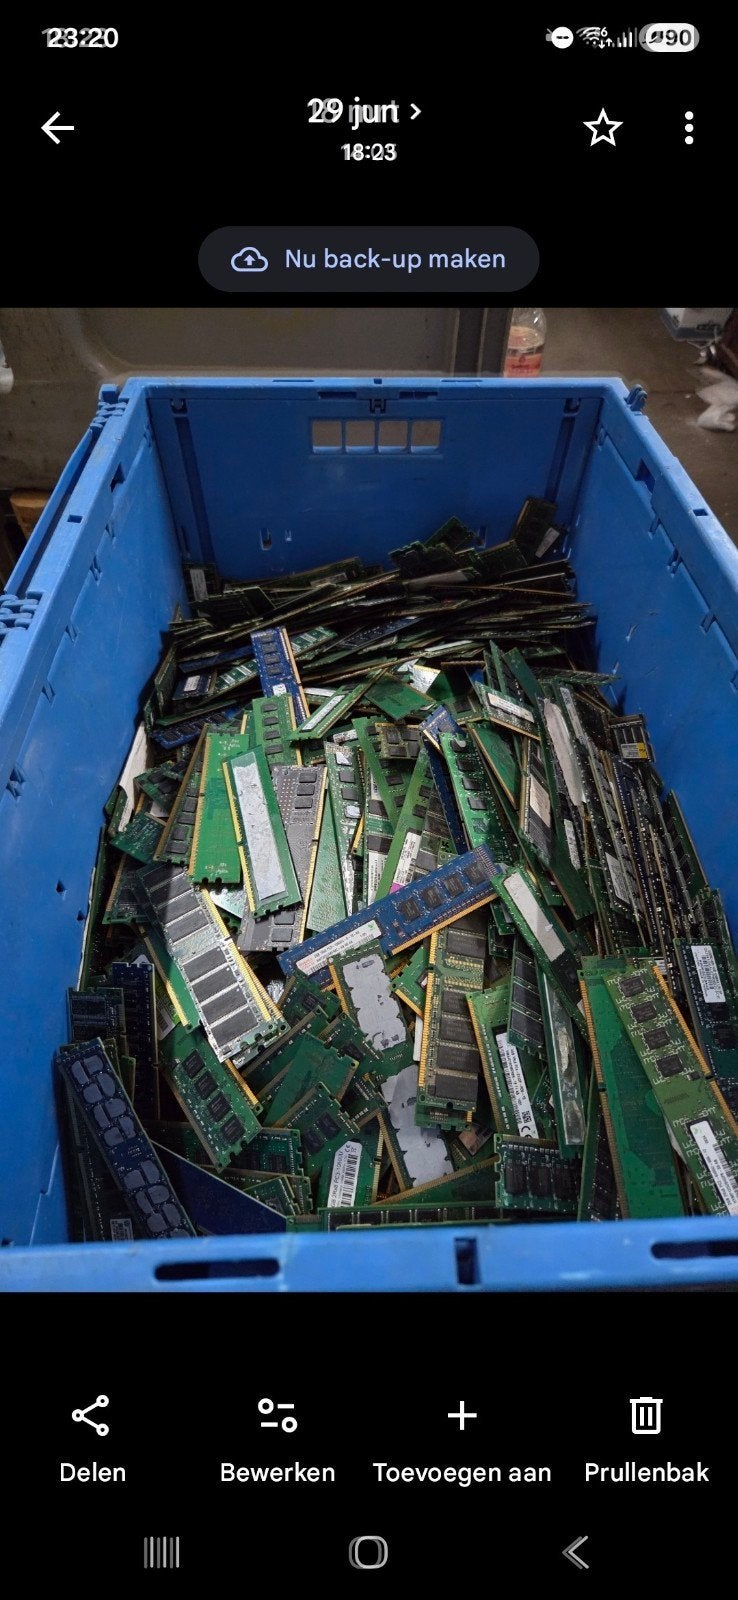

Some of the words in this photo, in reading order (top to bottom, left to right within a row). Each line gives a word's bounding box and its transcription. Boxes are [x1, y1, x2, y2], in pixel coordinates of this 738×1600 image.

[665, 29, 692, 46] 90
[307, 98, 344, 123] 29
[341, 143, 397, 161] 18:23
[286, 249, 315, 268] Nu
[325, 248, 421, 273] back-up
[429, 248, 505, 268] maken
[61, 1462, 125, 1482] Delen
[221, 1462, 335, 1482] Bewerken
[373, 1462, 501, 1487] Toevoegen
[509, 1467, 551, 1482] aan
[586, 1462, 709, 1482] Prullenbak
